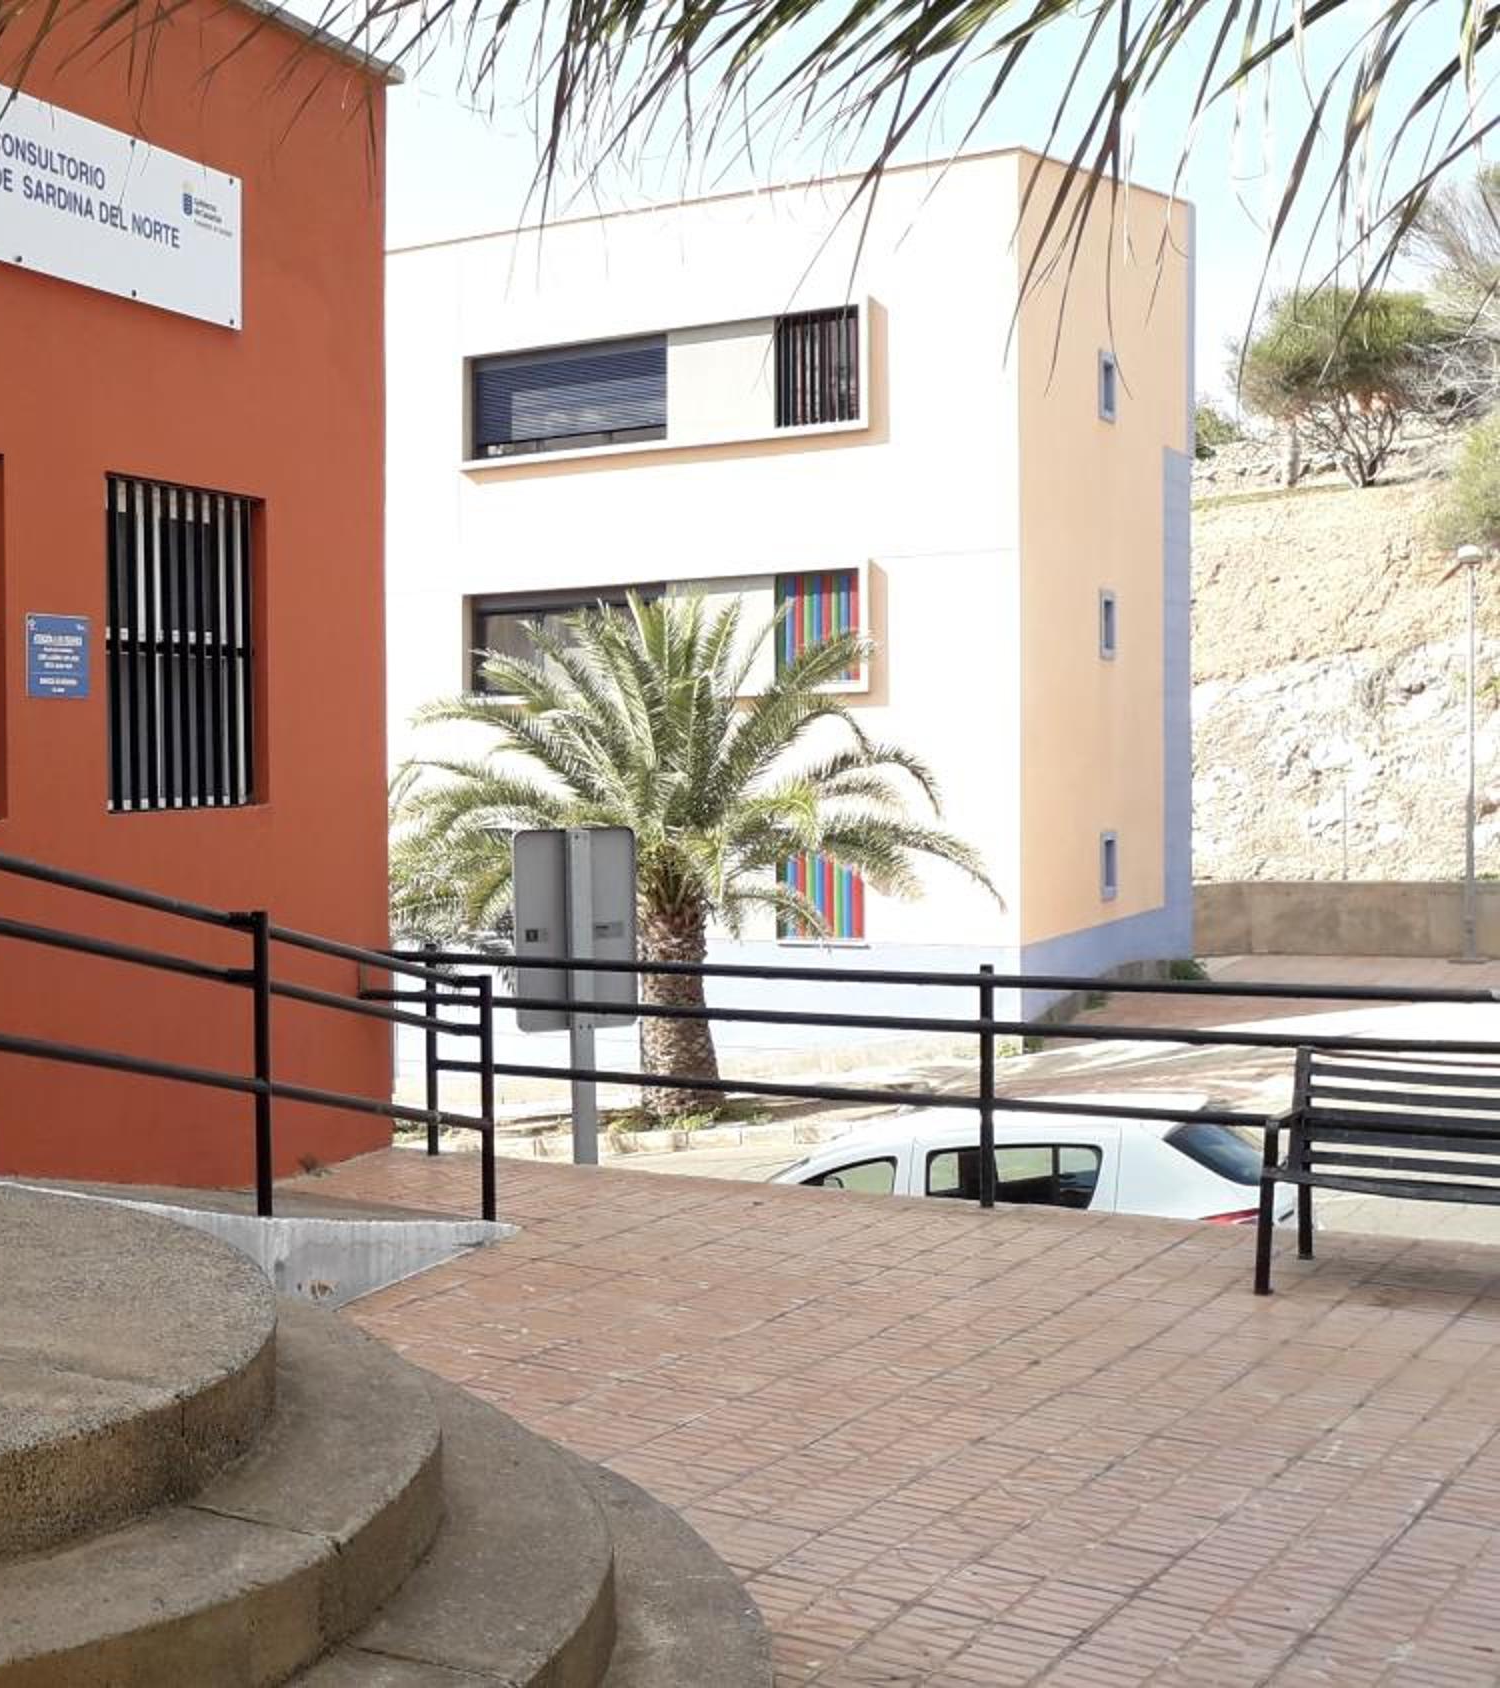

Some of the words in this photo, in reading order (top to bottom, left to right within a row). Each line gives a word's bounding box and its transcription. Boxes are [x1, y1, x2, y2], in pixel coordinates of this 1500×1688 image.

[23, 175, 94, 220] SARDINA
[99, 202, 128, 231] DEL
[132, 213, 180, 249] NORTE
